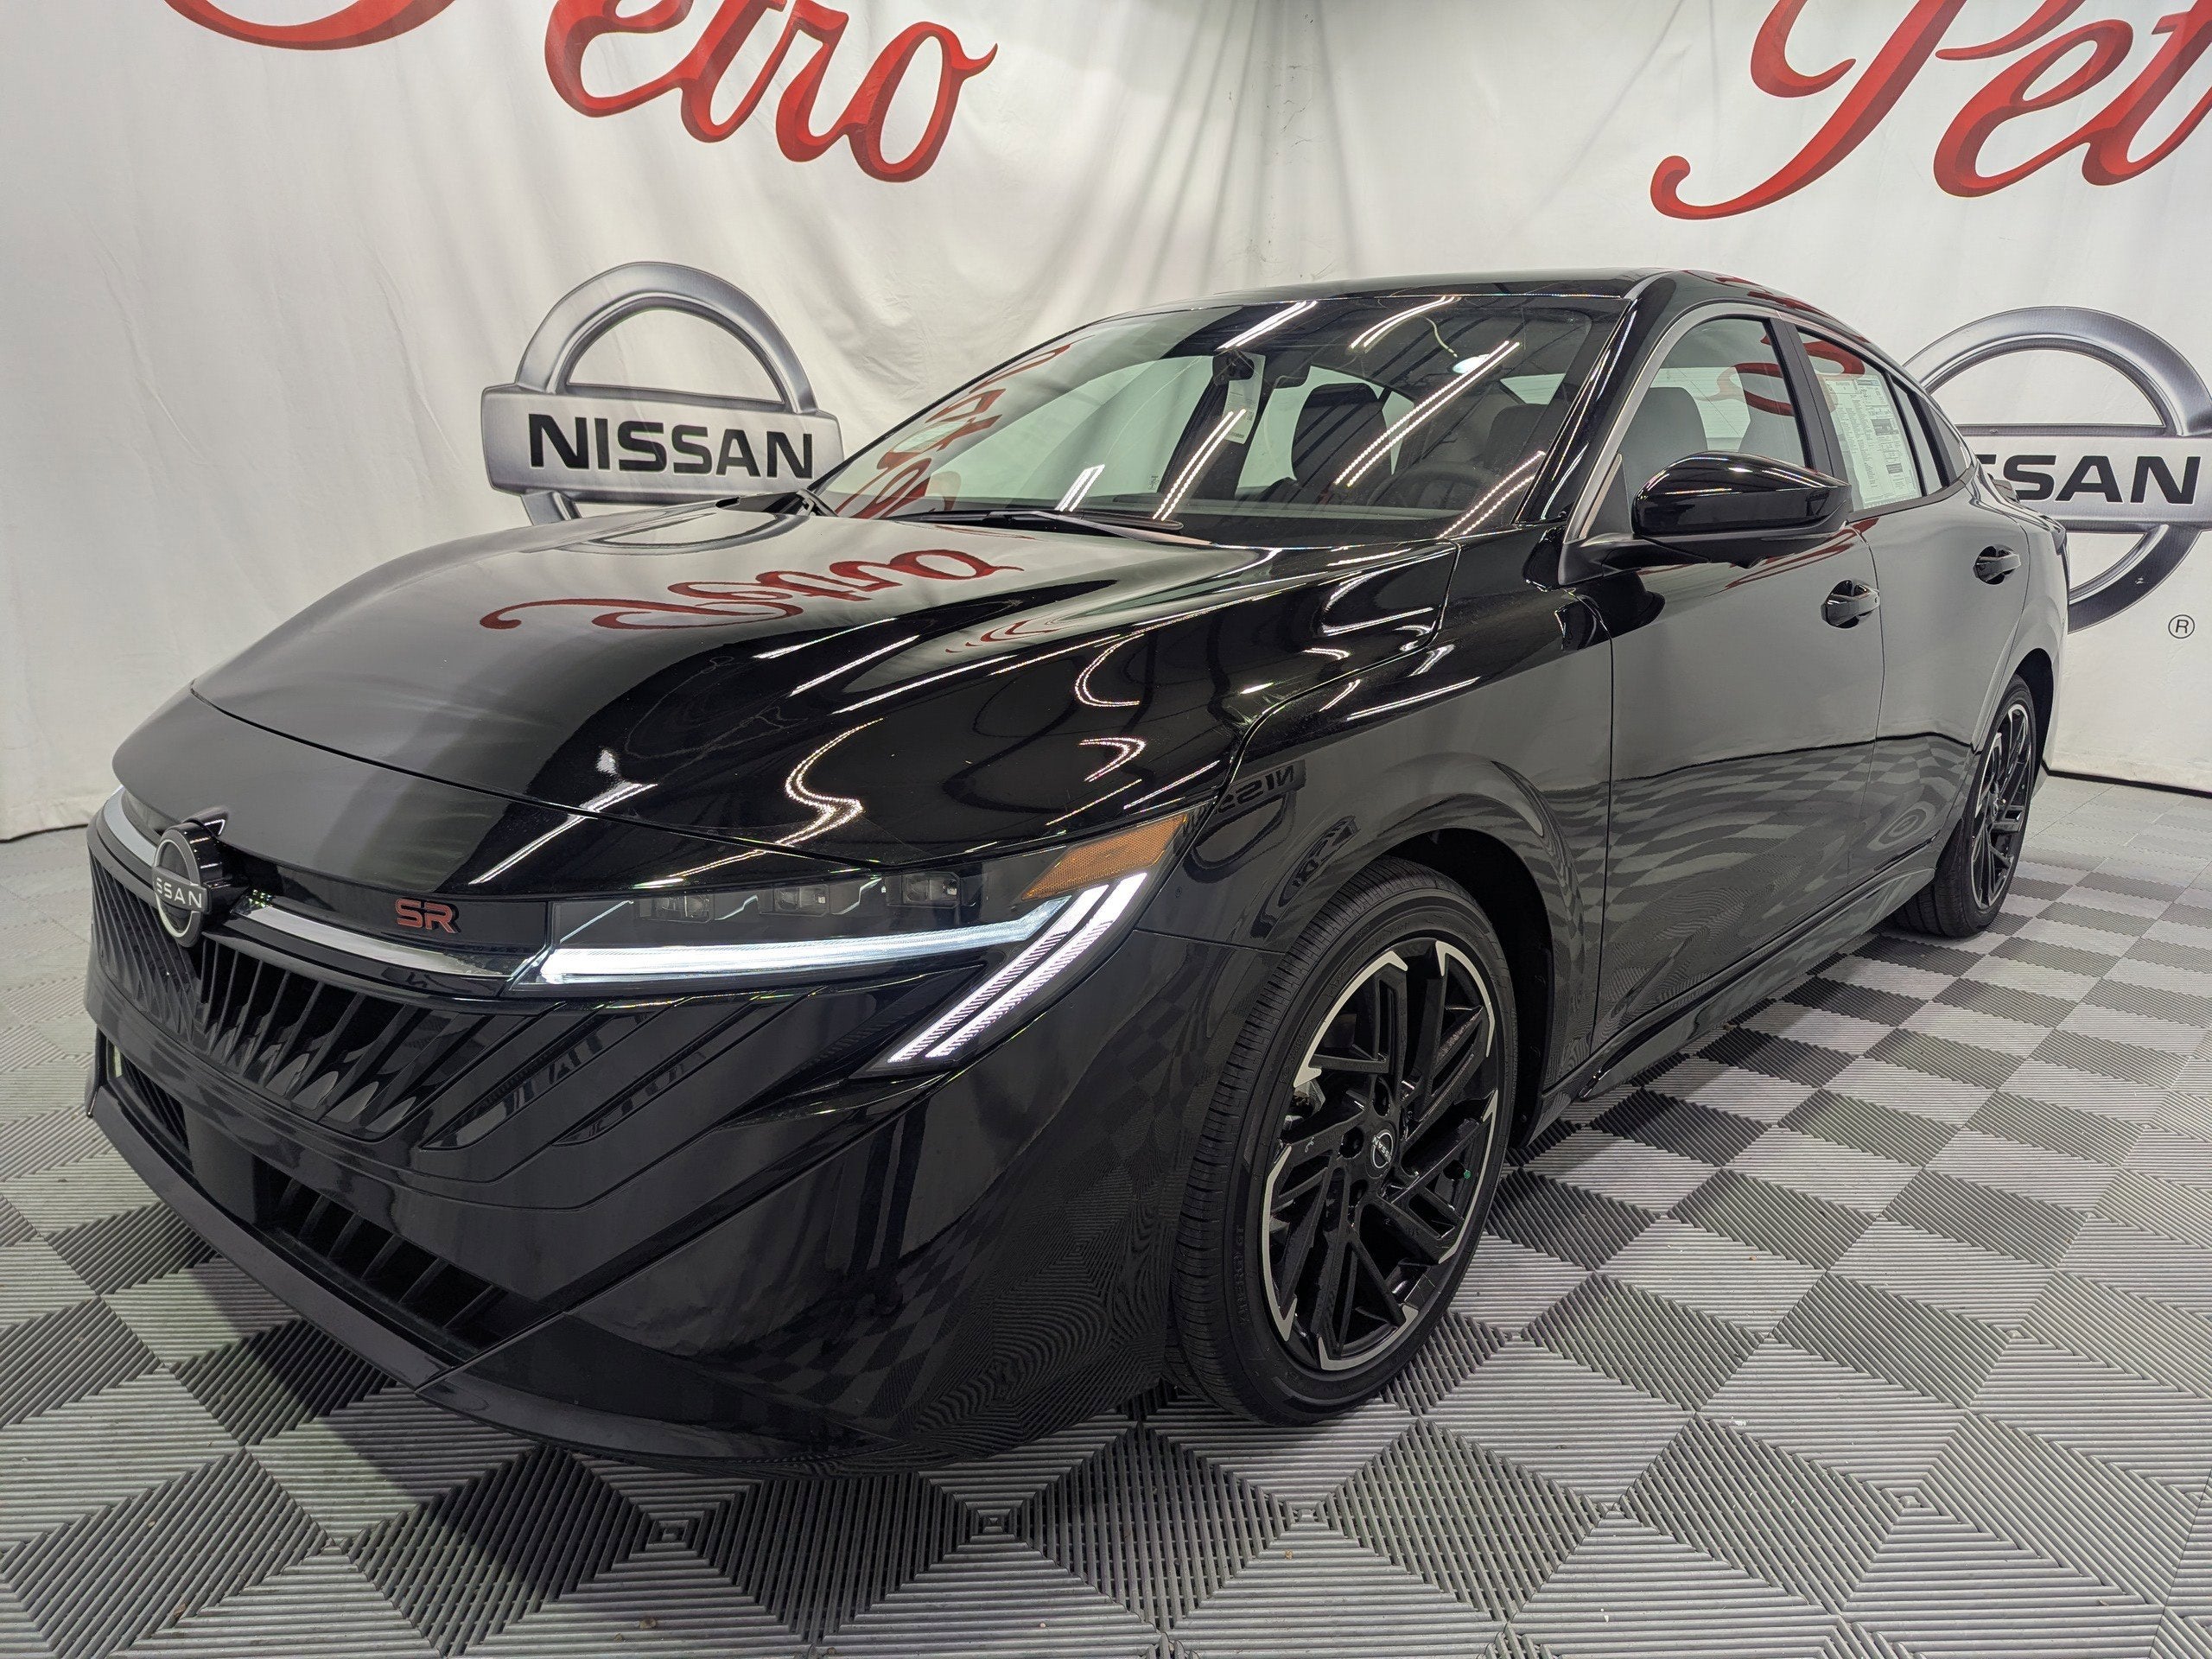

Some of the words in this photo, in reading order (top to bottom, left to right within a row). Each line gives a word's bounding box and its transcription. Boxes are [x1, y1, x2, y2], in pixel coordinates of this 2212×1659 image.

[164, 0, 998, 182] etro
[527, 412, 814, 480] NISSAN
[1974, 454, 2202, 505] SAN
[395, 898, 457, 934] SR
